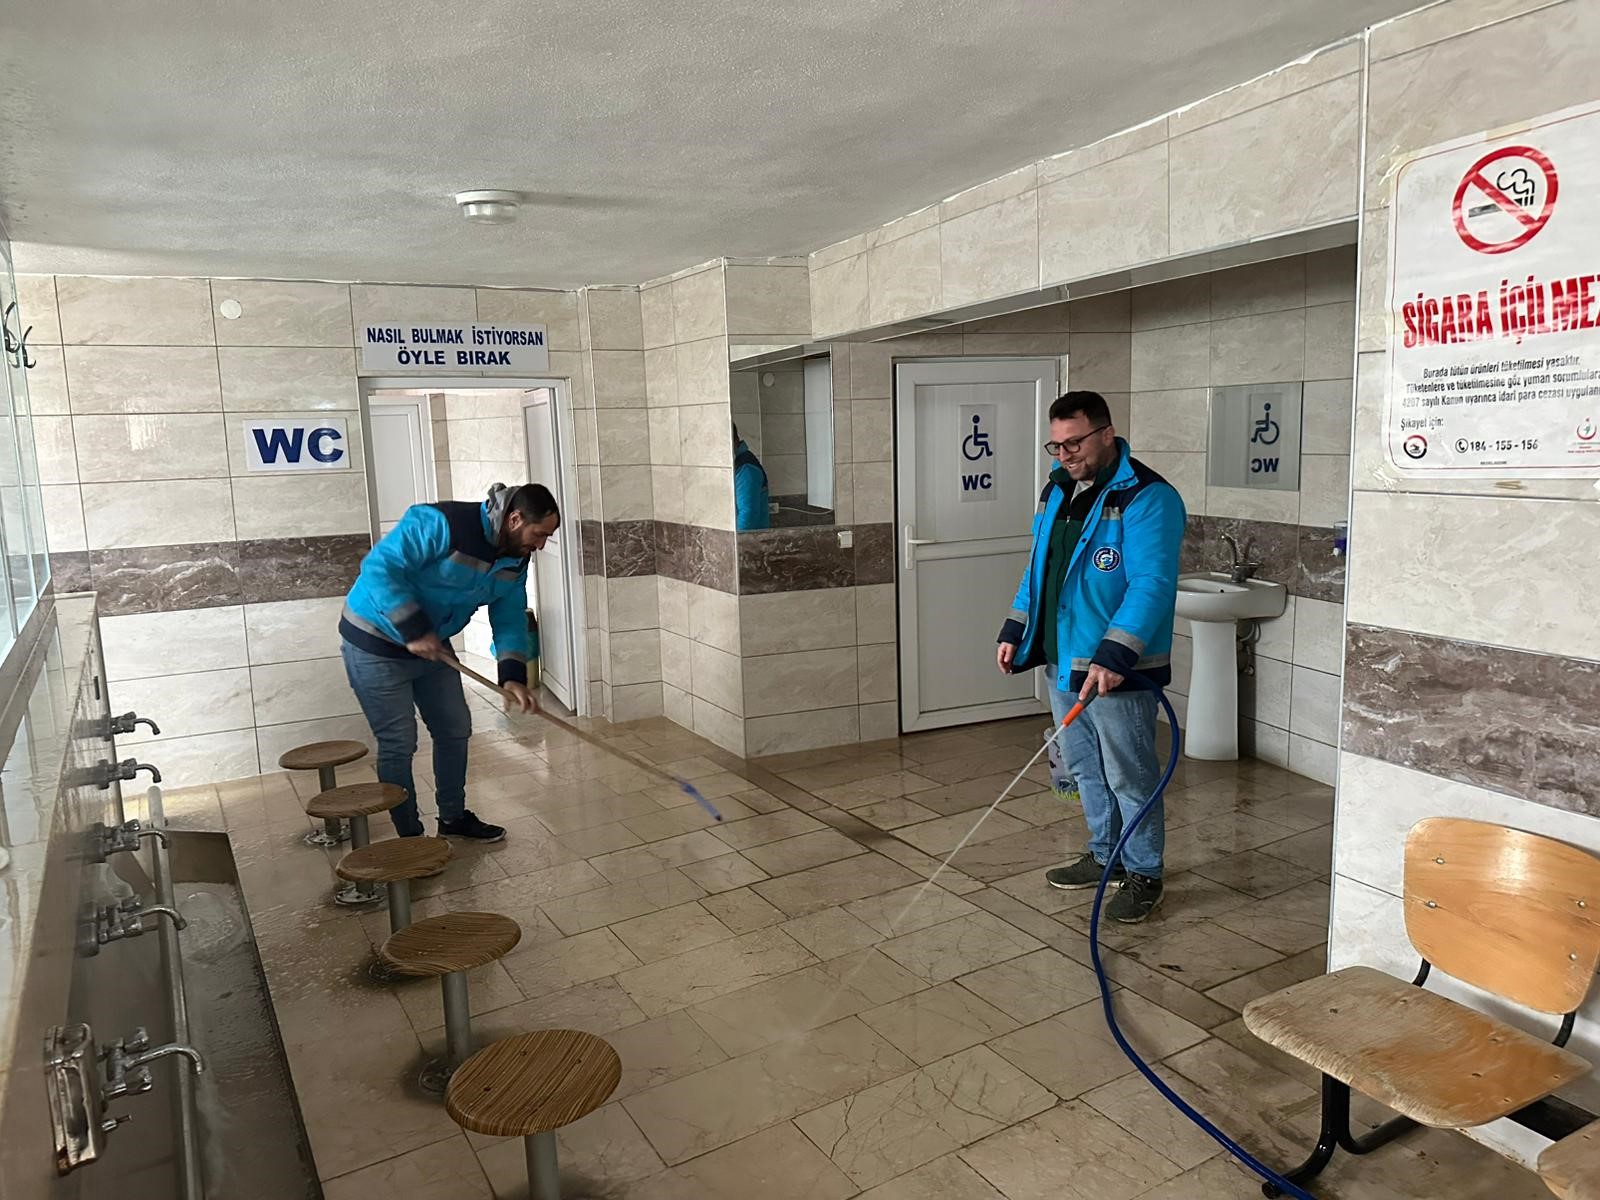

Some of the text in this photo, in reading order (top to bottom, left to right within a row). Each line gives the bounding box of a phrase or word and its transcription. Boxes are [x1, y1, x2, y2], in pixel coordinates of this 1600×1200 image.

[1402, 290, 1494, 349] SİGARA
[367, 325, 543, 346] NASIL BULMAK İSTİYORSAN
[397, 346, 511, 365] ÖYLE BIRAK
[1423, 367, 1448, 379] Burada
[1450, 364, 1468, 377] tütün
[1470, 361, 1499, 375] ürünleri
[1500, 357, 1544, 372] tüketilmesi
[1406, 381, 1445, 394] Tüketenlere
[1446, 382, 1455, 391] ve
[1456, 378, 1505, 390] tüketilmesine
[1508, 374, 1521, 388] göz
[1523, 373, 1550, 387] yuman
[1422, 395, 1440, 408] sayılı
[1441, 395, 1463, 406] Kanun
[1464, 393, 1497, 406] uyarınca
[1498, 390, 1516, 402] idari
[1518, 390, 1536, 403] para
[1538, 388, 1564, 400] cezası
[252, 427, 344, 464] WC
[1470, 441, 1487, 451] 184
[1496, 440, 1513, 451] 155
[1522, 439, 1539, 450] 156
[962, 473, 993, 491] WC
